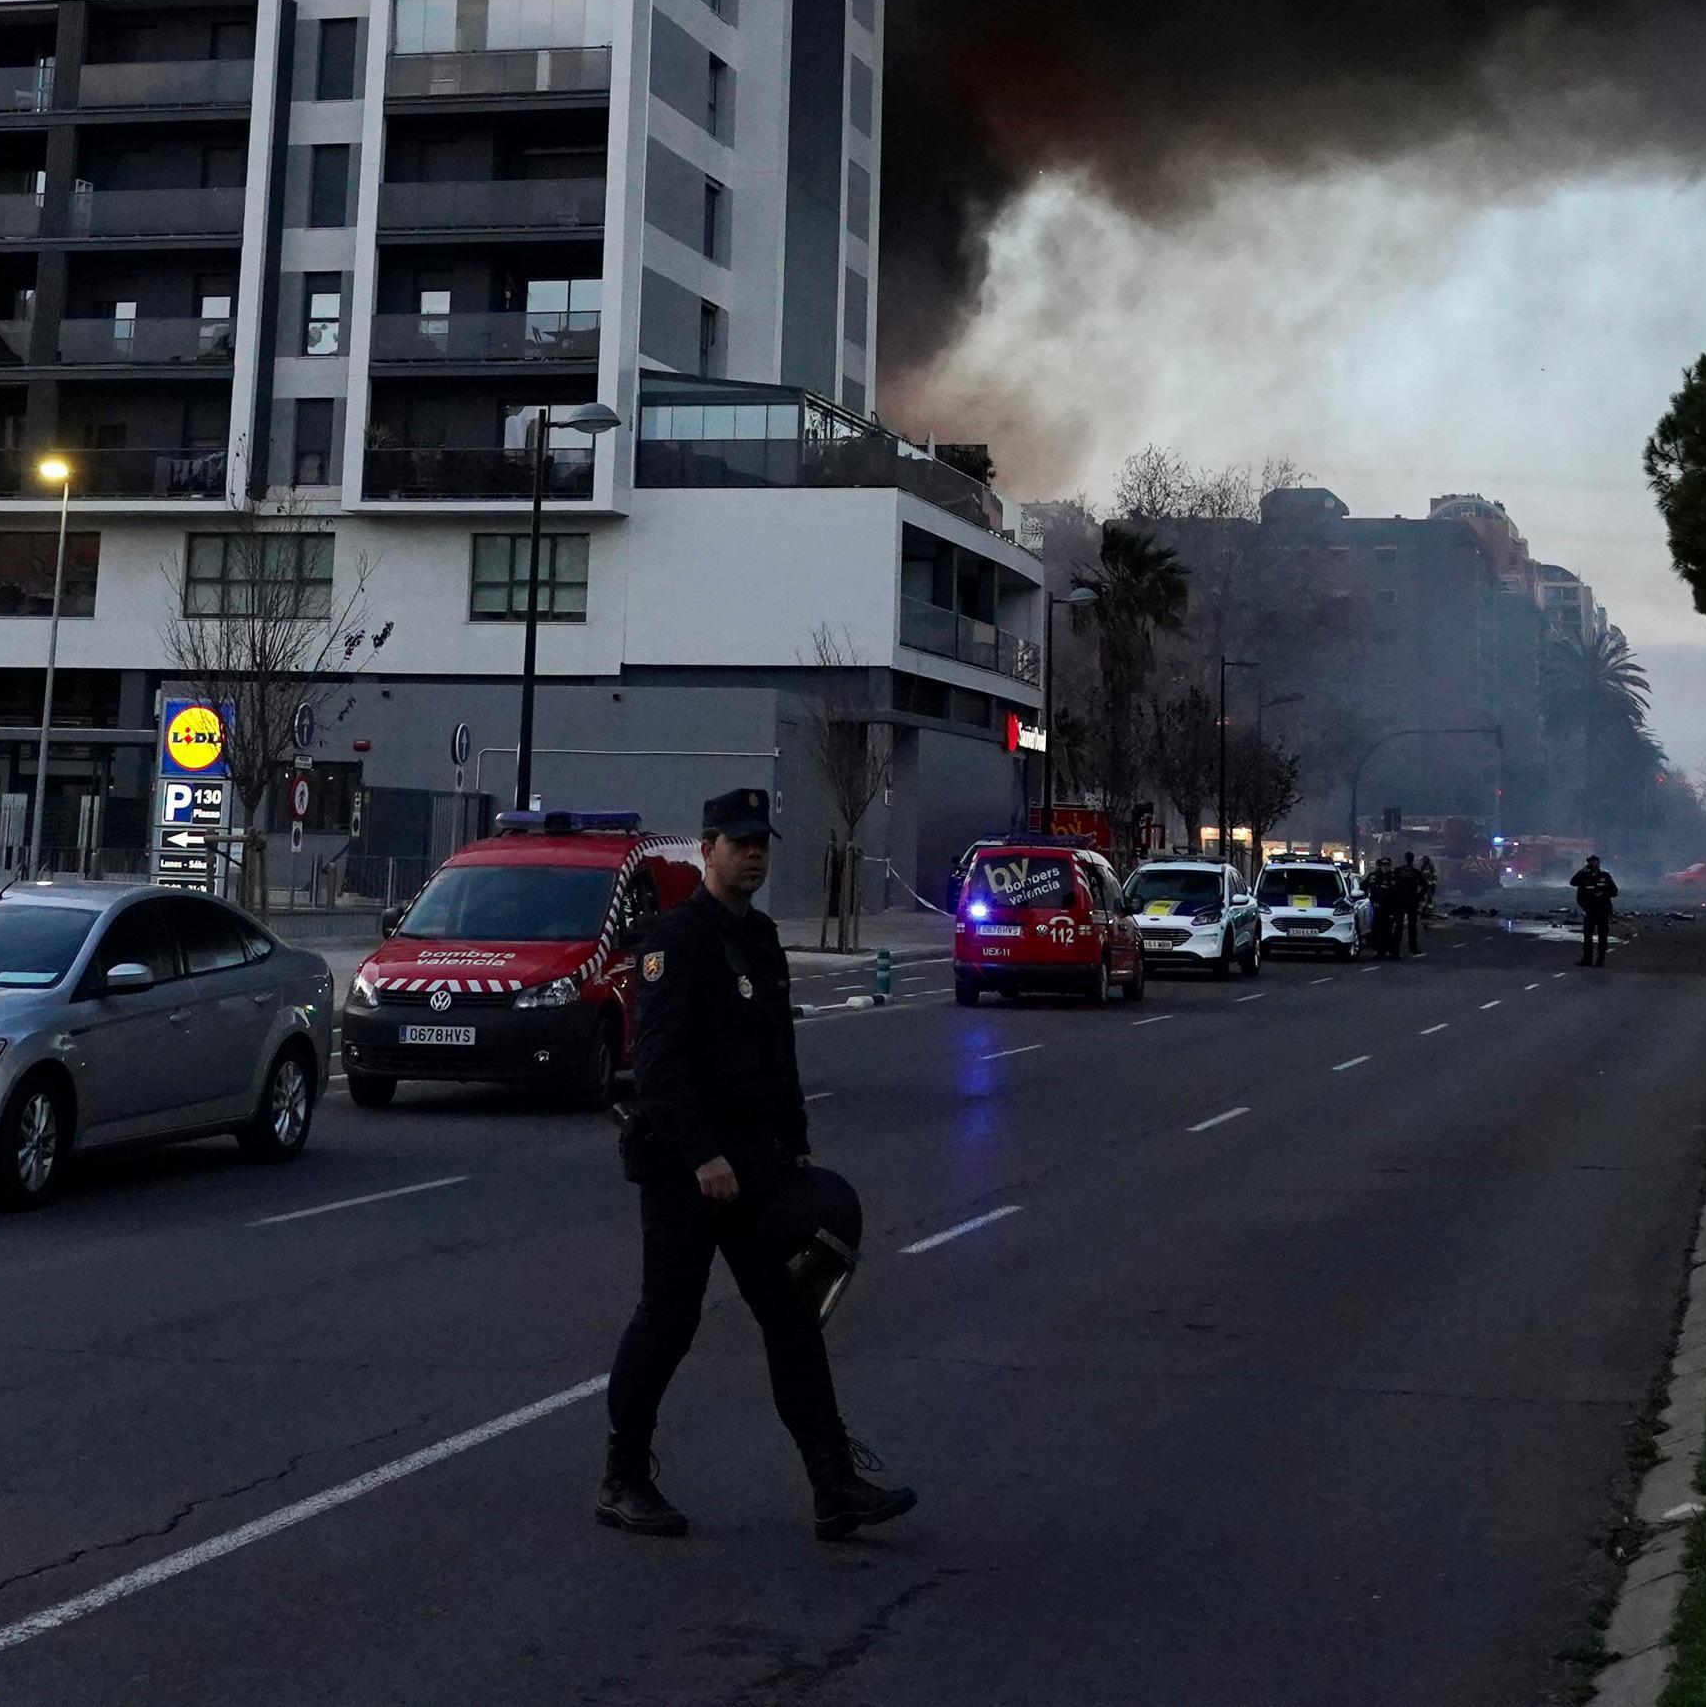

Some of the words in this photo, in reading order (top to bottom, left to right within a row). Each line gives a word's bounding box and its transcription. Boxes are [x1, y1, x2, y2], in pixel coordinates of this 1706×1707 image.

[165, 783, 192, 821] P
[194, 789, 222, 805] 130
[193, 808, 221, 819] Plazas
[160, 859, 183, 869] Lunes
[1050, 927, 1075, 944] 112
[418, 950, 517, 960] bombers
[982, 947, 1011, 957] UEX-11
[416, 957, 507, 967] valencia
[409, 1027, 471, 1042] 0678HVS
